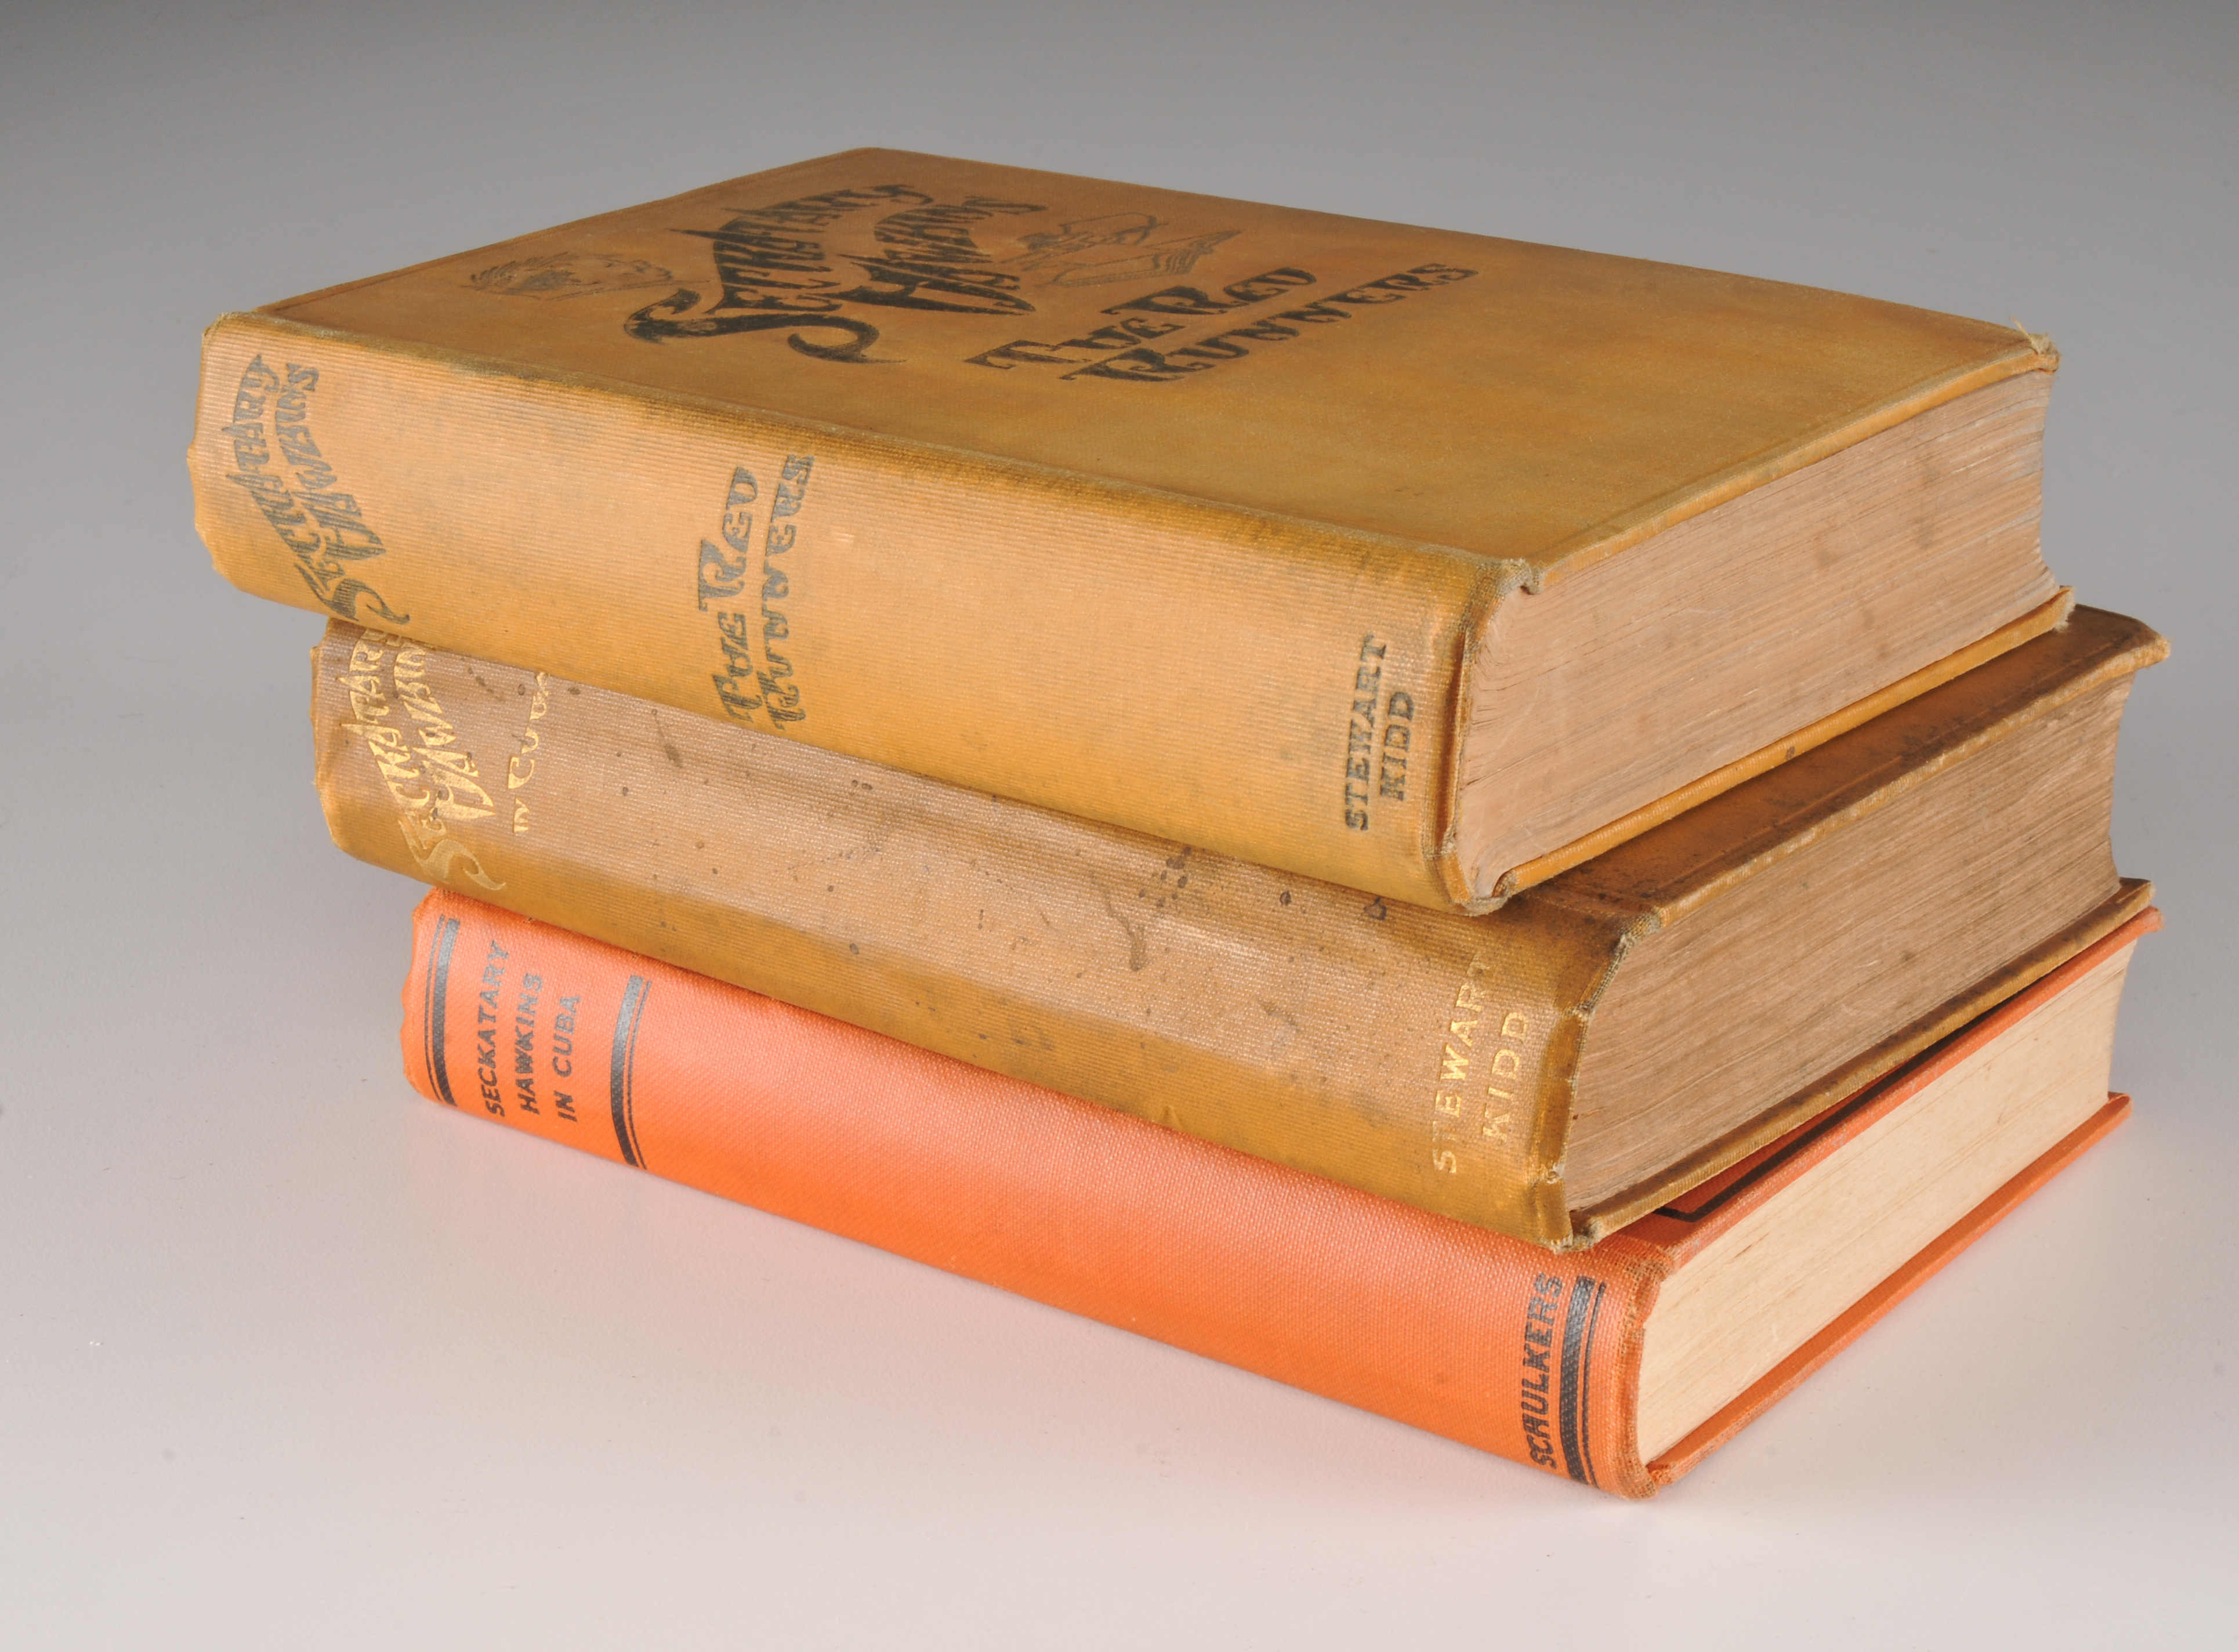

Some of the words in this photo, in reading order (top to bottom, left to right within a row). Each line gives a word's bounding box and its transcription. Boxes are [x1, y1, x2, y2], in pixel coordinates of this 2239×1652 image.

[624, 184, 933, 364] SECKATARY
[805, 195, 1048, 316] HAWKINS
[964, 317, 1185, 369] THE
[1100, 267, 1317, 315] RED
[1059, 263, 1479, 382] RUNNERS
[222, 353, 410, 625] SECKATARY
[275, 363, 386, 561] HAWKINS
[698, 466, 758, 611] RED
[757, 454, 815, 730] RUNNERS
[394, 642, 496, 821] HAWKIN
[712, 612, 763, 723] THE
[1345, 634, 1387, 831] STEWART
[1380, 691, 1415, 801] KIDD
[477, 940, 509, 1117] SECKATARY
[514, 972, 543, 1115] HAWKINS
[552, 995, 581, 1078] CUBA
[1432, 951, 1490, 1173] STEWART
[1483, 1011, 1529, 1143] KIDD
[553, 1090, 578, 1122] IN
